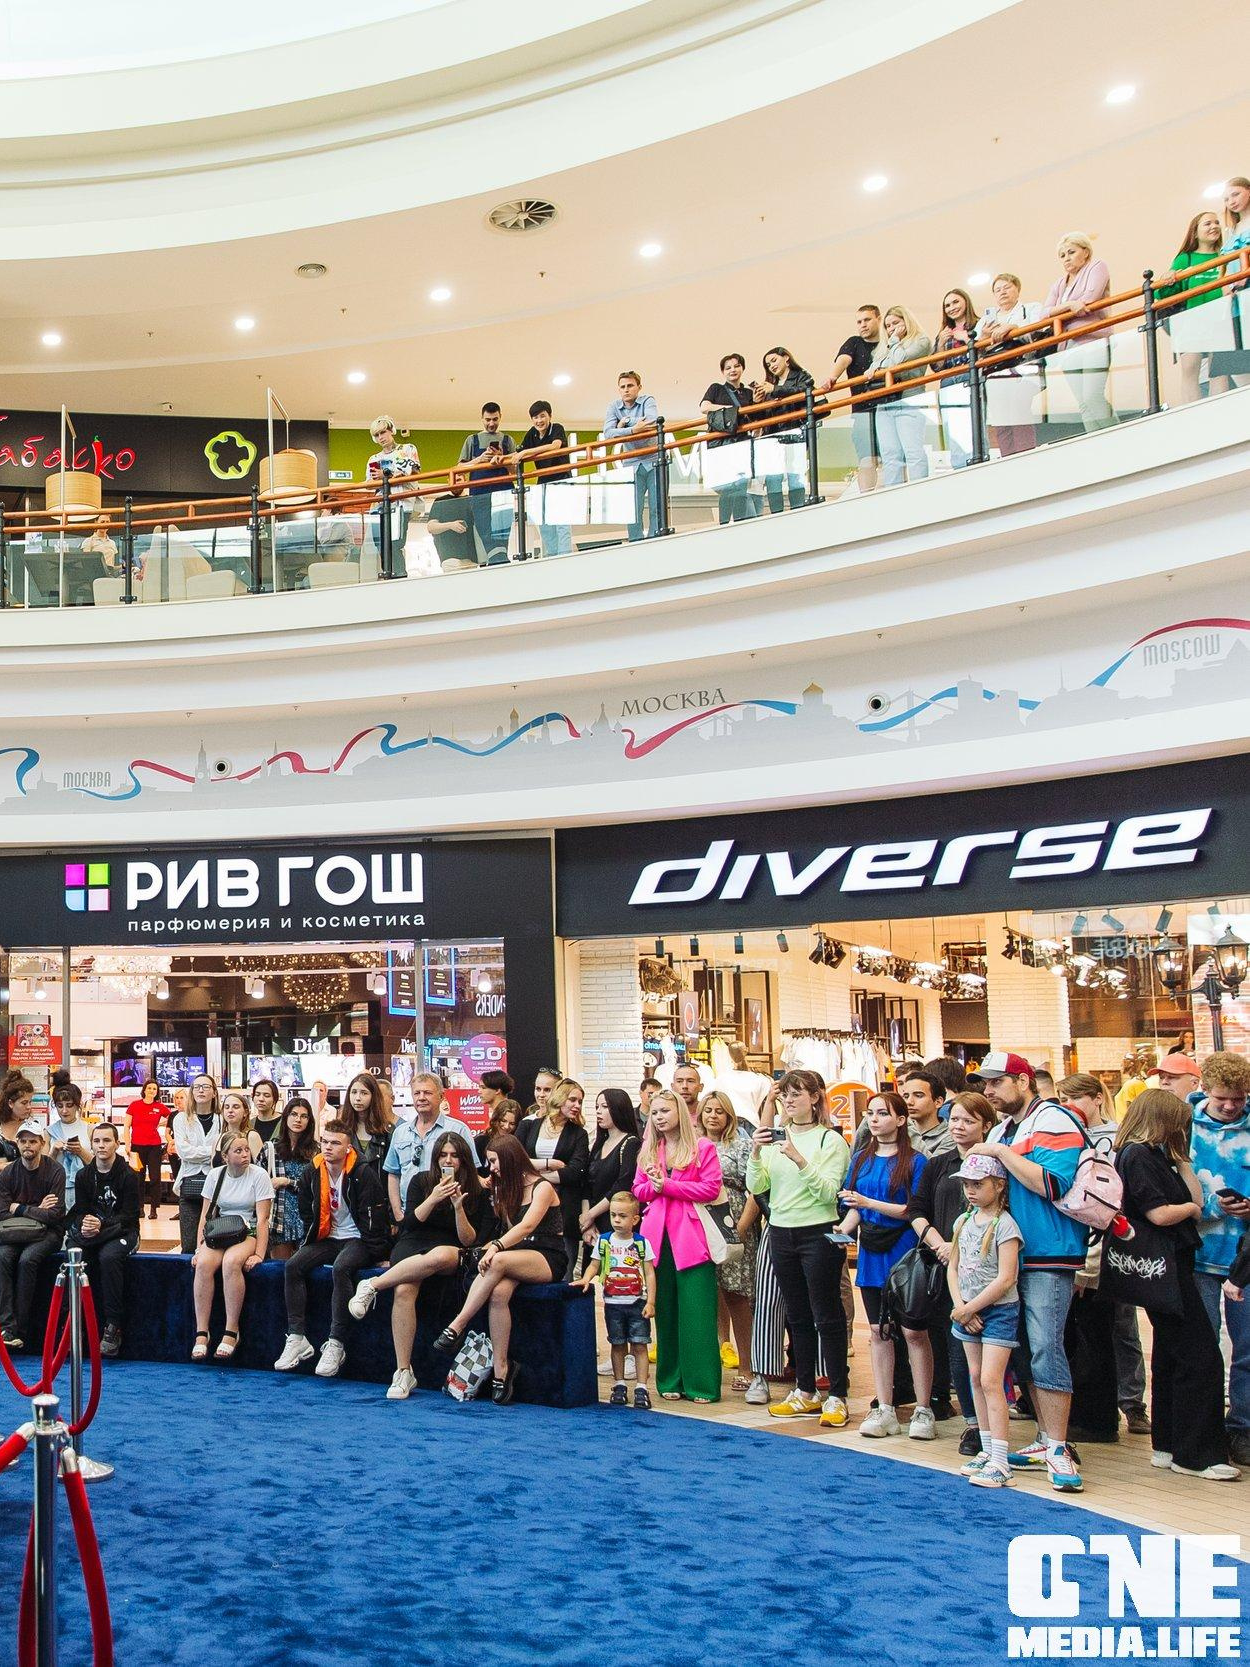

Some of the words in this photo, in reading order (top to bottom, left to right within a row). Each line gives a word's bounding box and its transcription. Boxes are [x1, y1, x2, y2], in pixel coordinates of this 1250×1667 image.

[1143, 634, 1220, 667] MOSCOW
[620, 687, 727, 717] МОСКВА
[63, 771, 111, 789] МОСКВА
[628, 808, 1212, 905] diverse
[127, 859, 260, 911] РИВ
[278, 853, 424, 907] ГОШ
[128, 917, 270, 933] парфюмерия
[280, 919, 292, 929] и
[302, 914, 425, 929] косметика
[133, 1041, 183, 1053] CHANEL
[293, 1038, 331, 1053] Dior
[401, 1038, 417, 1053] Dior
